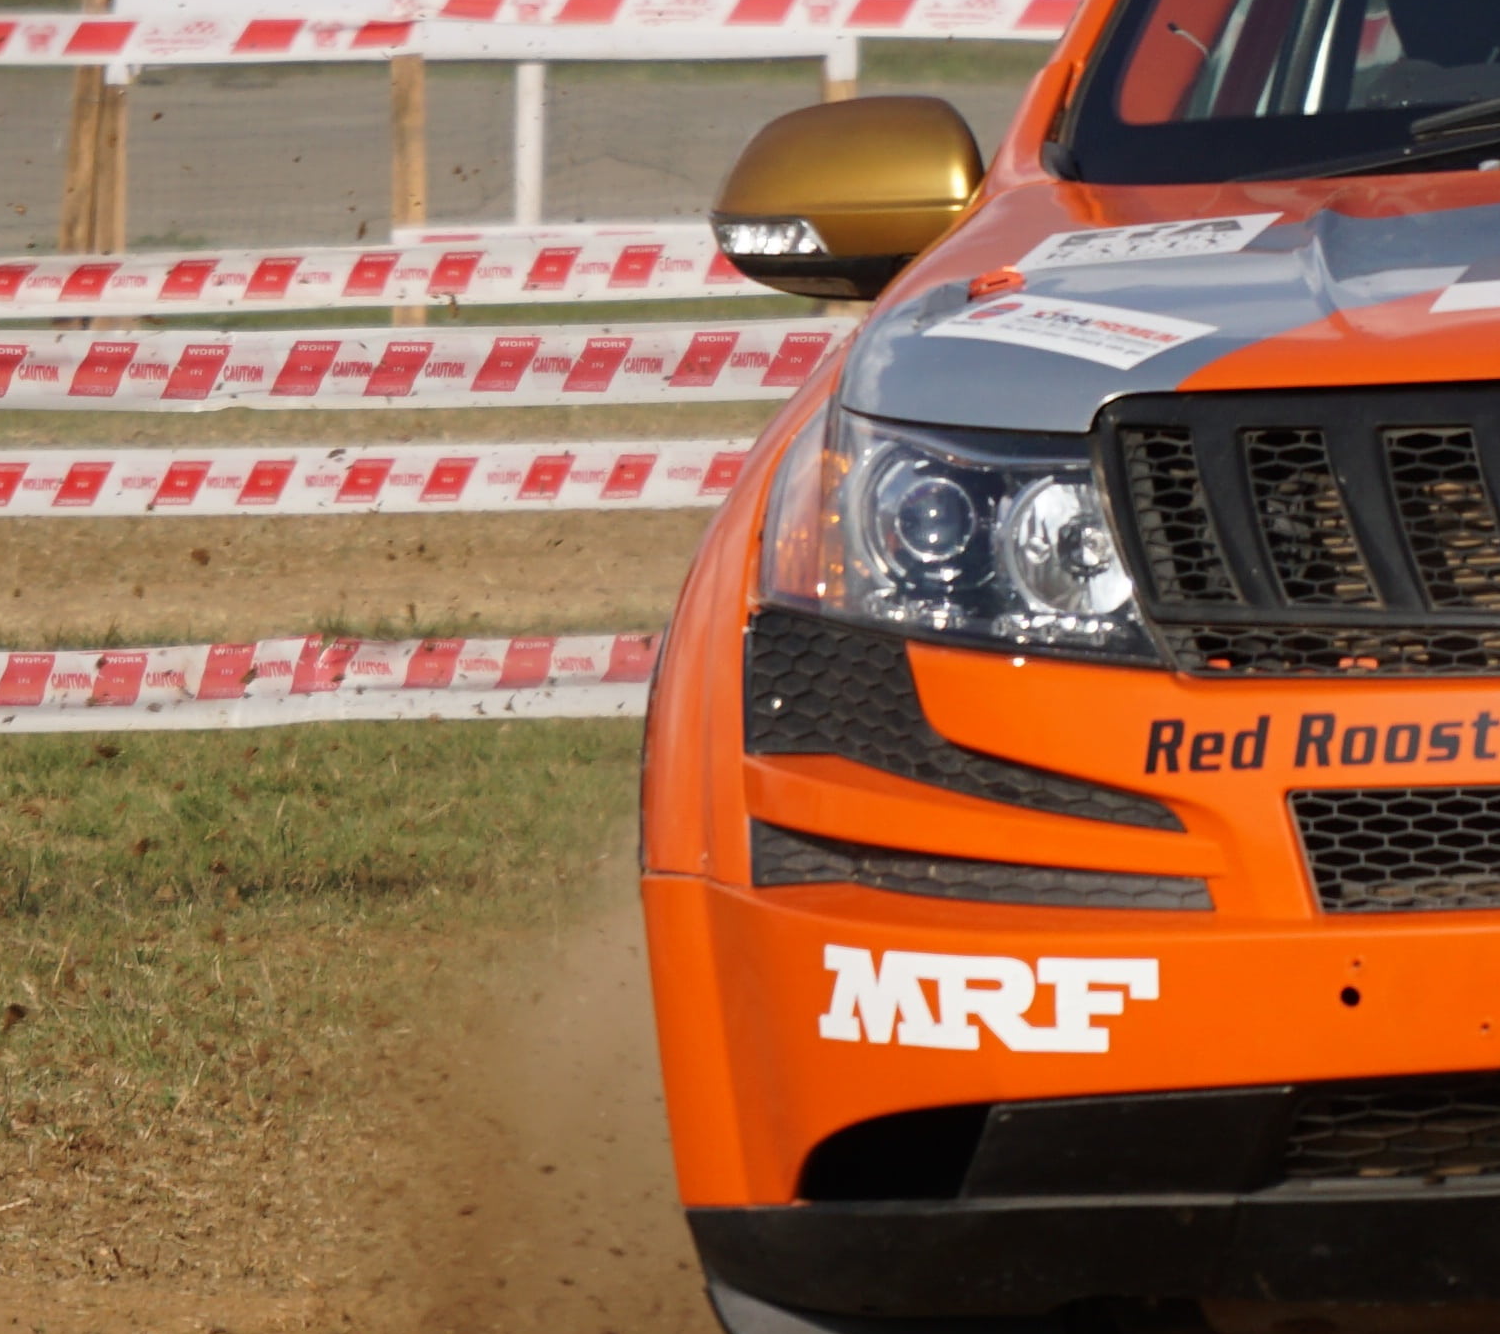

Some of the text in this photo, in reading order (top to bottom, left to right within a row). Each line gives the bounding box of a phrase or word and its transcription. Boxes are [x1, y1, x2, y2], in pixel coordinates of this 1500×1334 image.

[500, 339, 535, 348] WORK
[591, 340, 626, 348] WORK
[697, 335, 732, 343] WORK
[789, 335, 824, 343] WORK
[95, 346, 131, 354] WORK
[189, 348, 225, 356] WORK
[298, 344, 334, 352] WORK
[391, 345, 427, 353] WORK
[533, 358, 573, 374] CAUTION
[623, 357, 663, 373] CAUTION
[730, 352, 770, 368] CAUTION
[19, 364, 59, 381] CAUTION
[129, 363, 170, 380] CAUTION
[224, 366, 264, 382] CAUTION
[332, 361, 373, 378] CAUTION
[425, 362, 465, 378] CAUTION
[254, 661, 293, 677] CAUTION
[351, 661, 391, 676] CAUTION
[459, 658, 499, 673] CAUTION
[553, 657, 594, 672] CAUTION
[51, 673, 92, 689] CAUTION
[146, 672, 186, 688] CAUTION
[1145, 715, 1270, 775] Red
[819, 944, 1159, 1054] MRF
